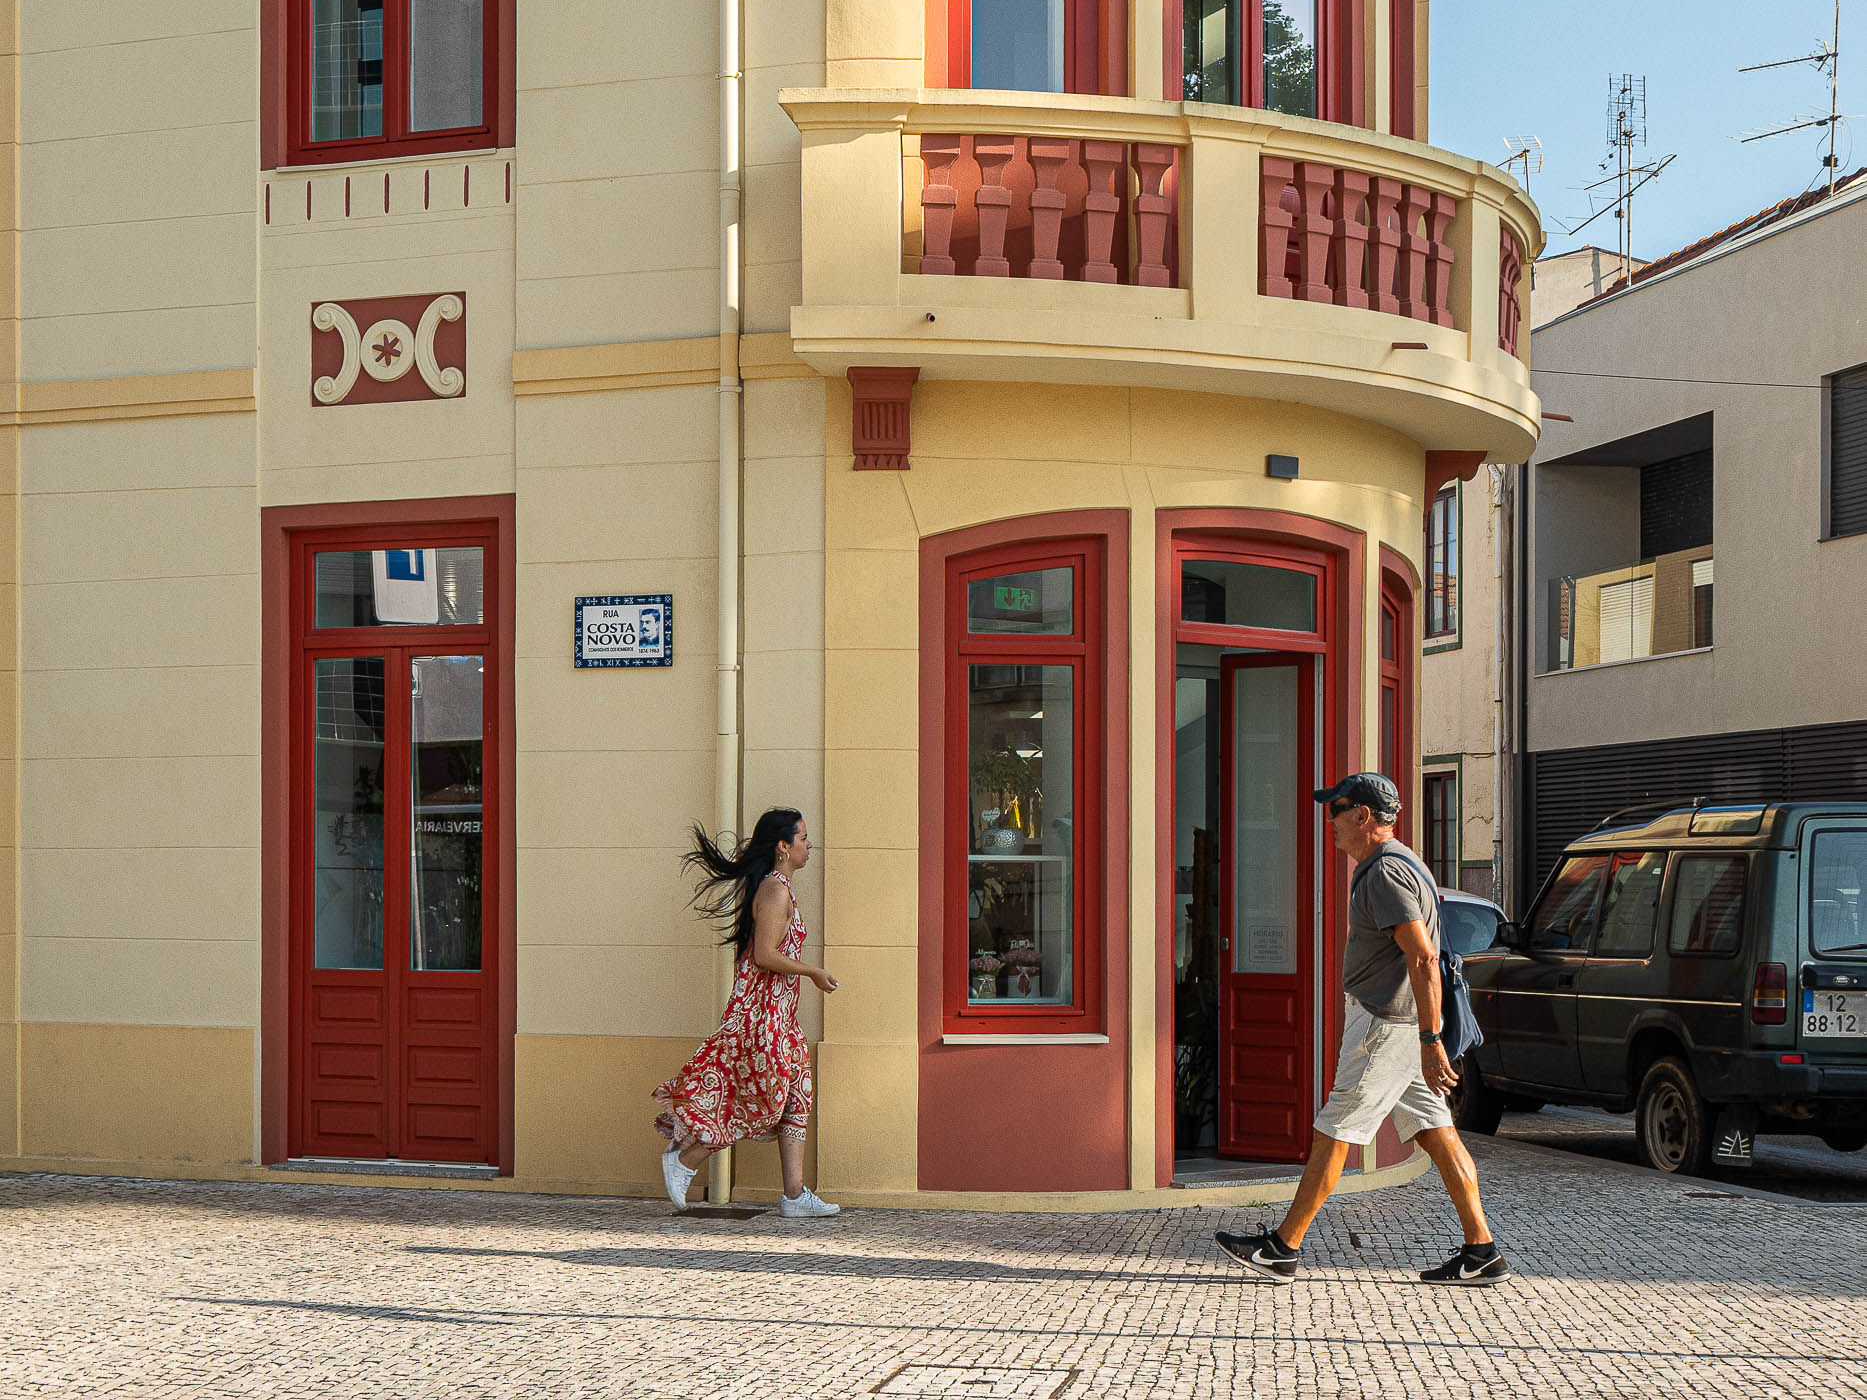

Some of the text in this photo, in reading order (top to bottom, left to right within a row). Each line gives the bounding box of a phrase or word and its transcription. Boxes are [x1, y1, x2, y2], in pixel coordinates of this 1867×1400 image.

[603, 610, 619, 618] RUA
[587, 623, 635, 634] COSTA
[587, 634, 636, 645] NOVO
[1828, 994, 1846, 1012] 12
